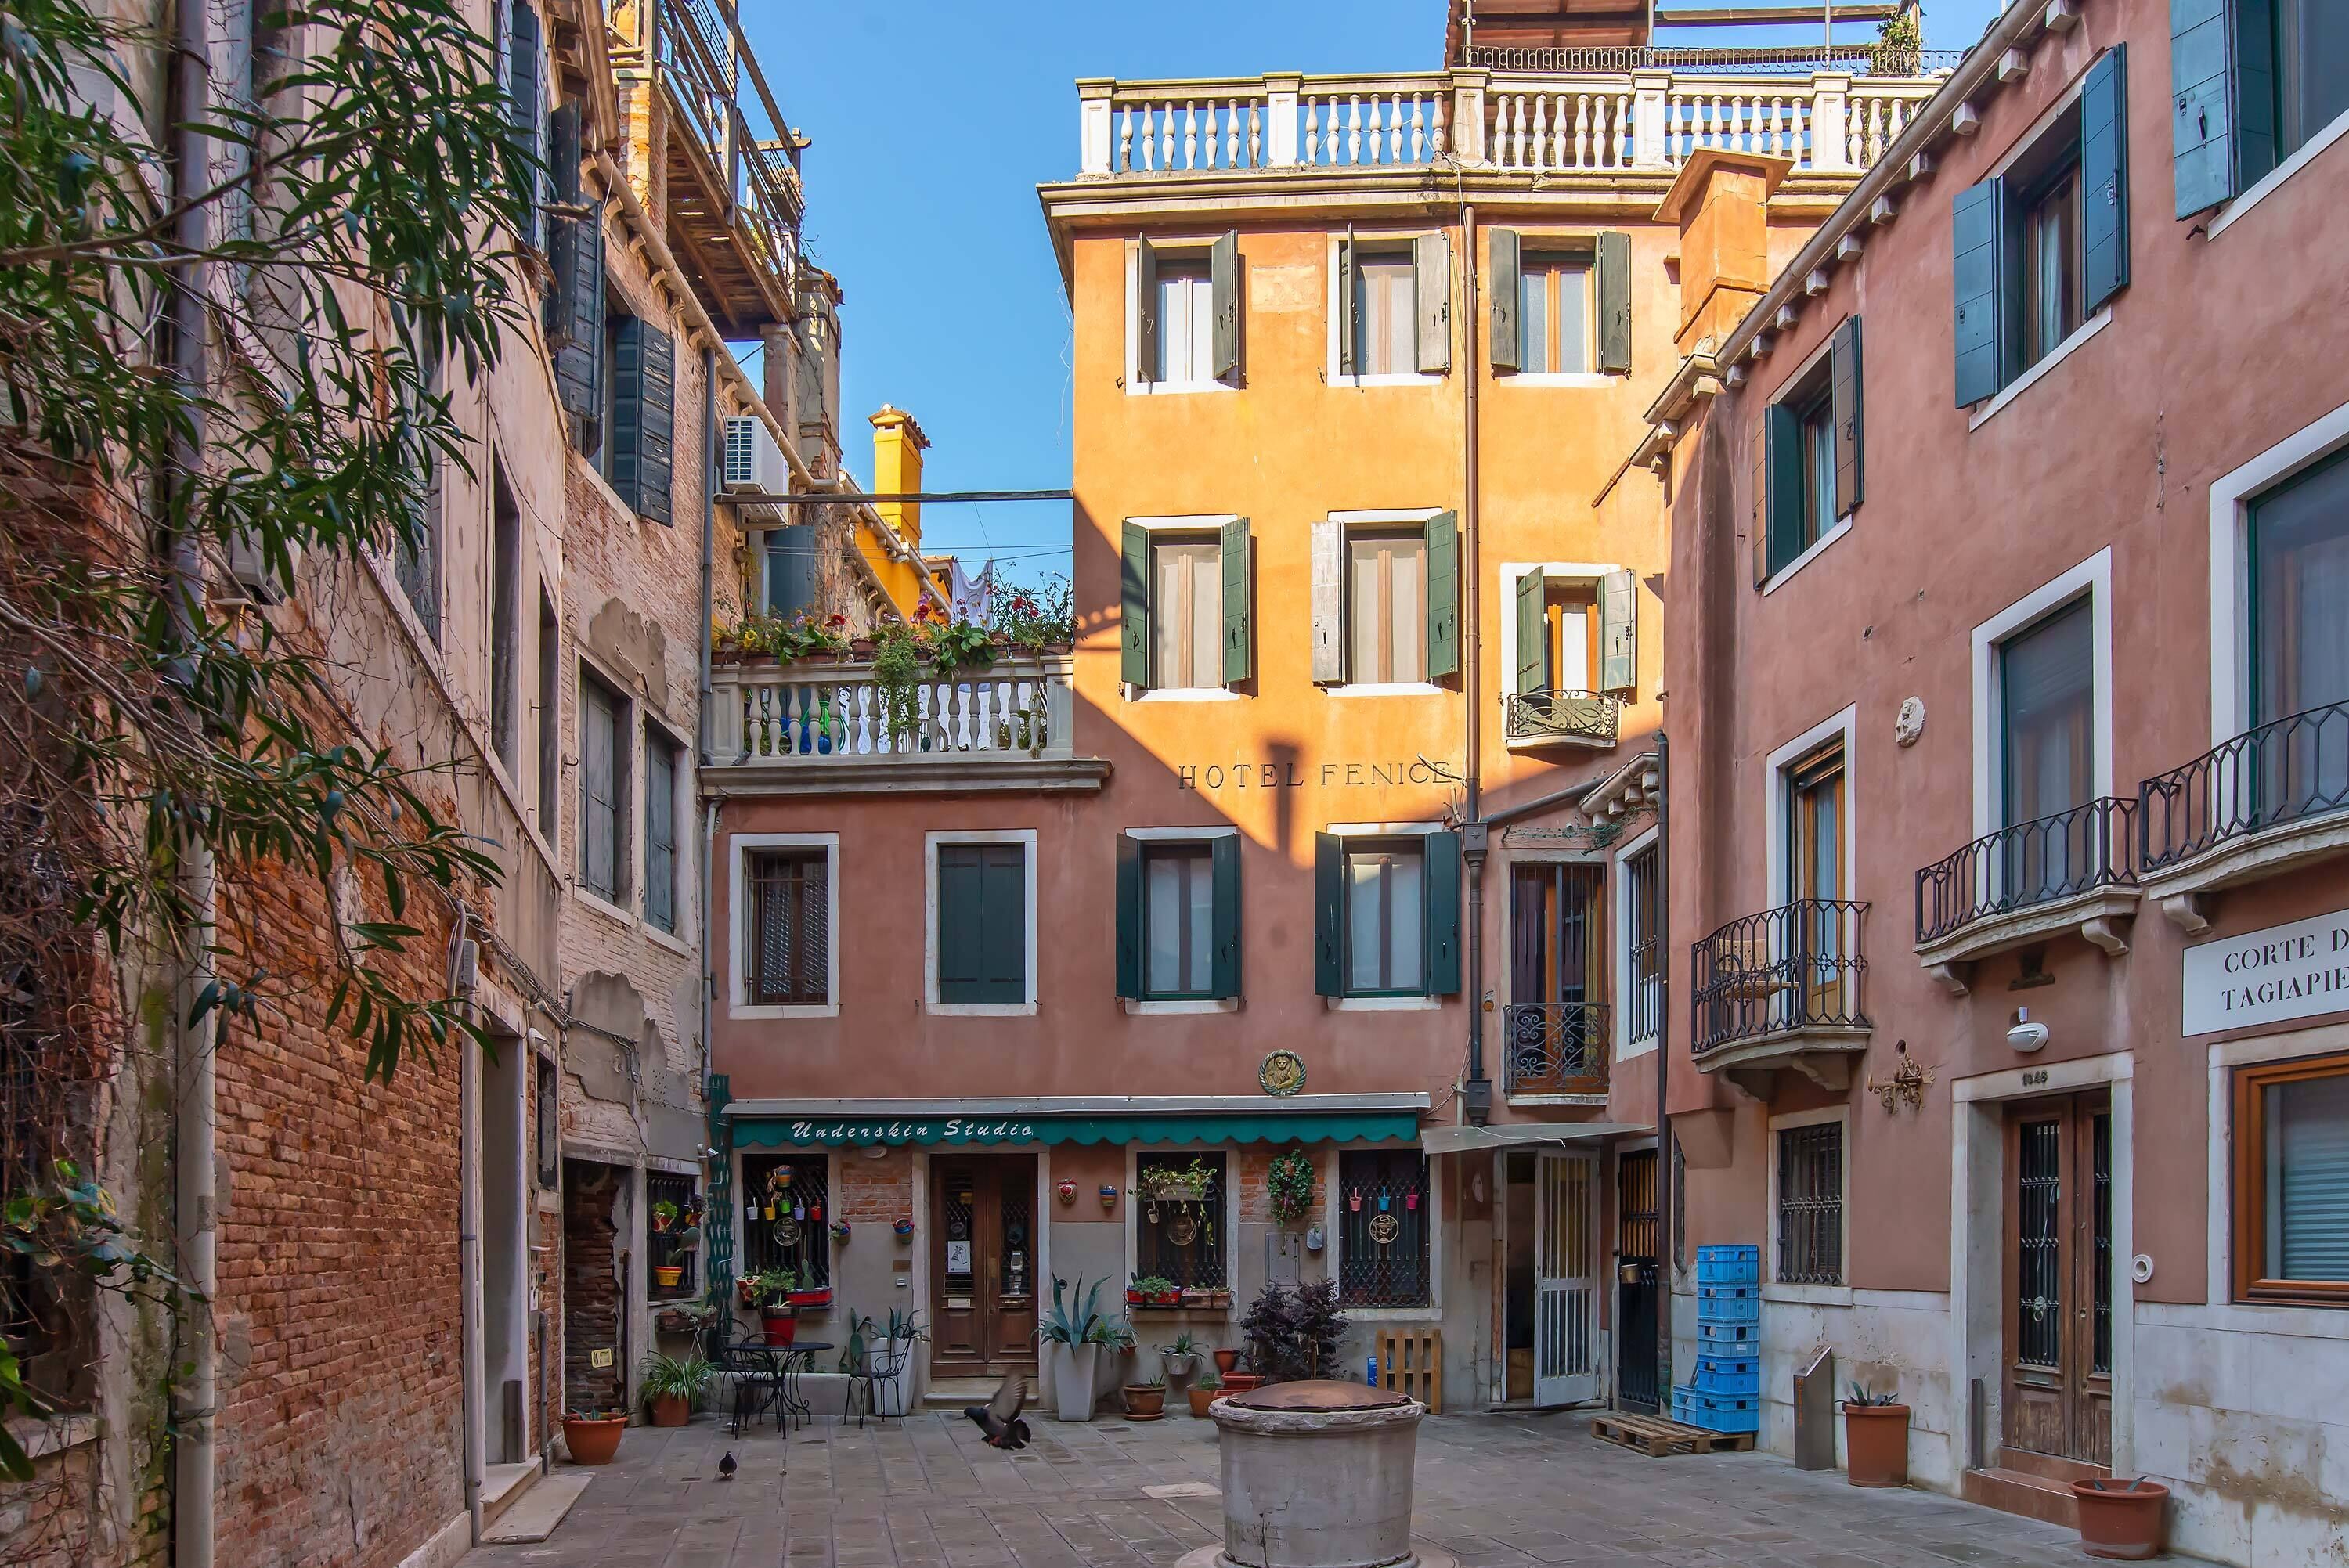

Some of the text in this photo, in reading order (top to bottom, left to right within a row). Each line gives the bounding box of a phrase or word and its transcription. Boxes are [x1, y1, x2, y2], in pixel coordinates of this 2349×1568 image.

[1178, 762, 1452, 789] HOTEL FENICE
[2224, 928, 2349, 973] CORTE D
[2221, 967, 2349, 1011] TAGIAPIE
[792, 1119, 1034, 1138] Underskin Studio
